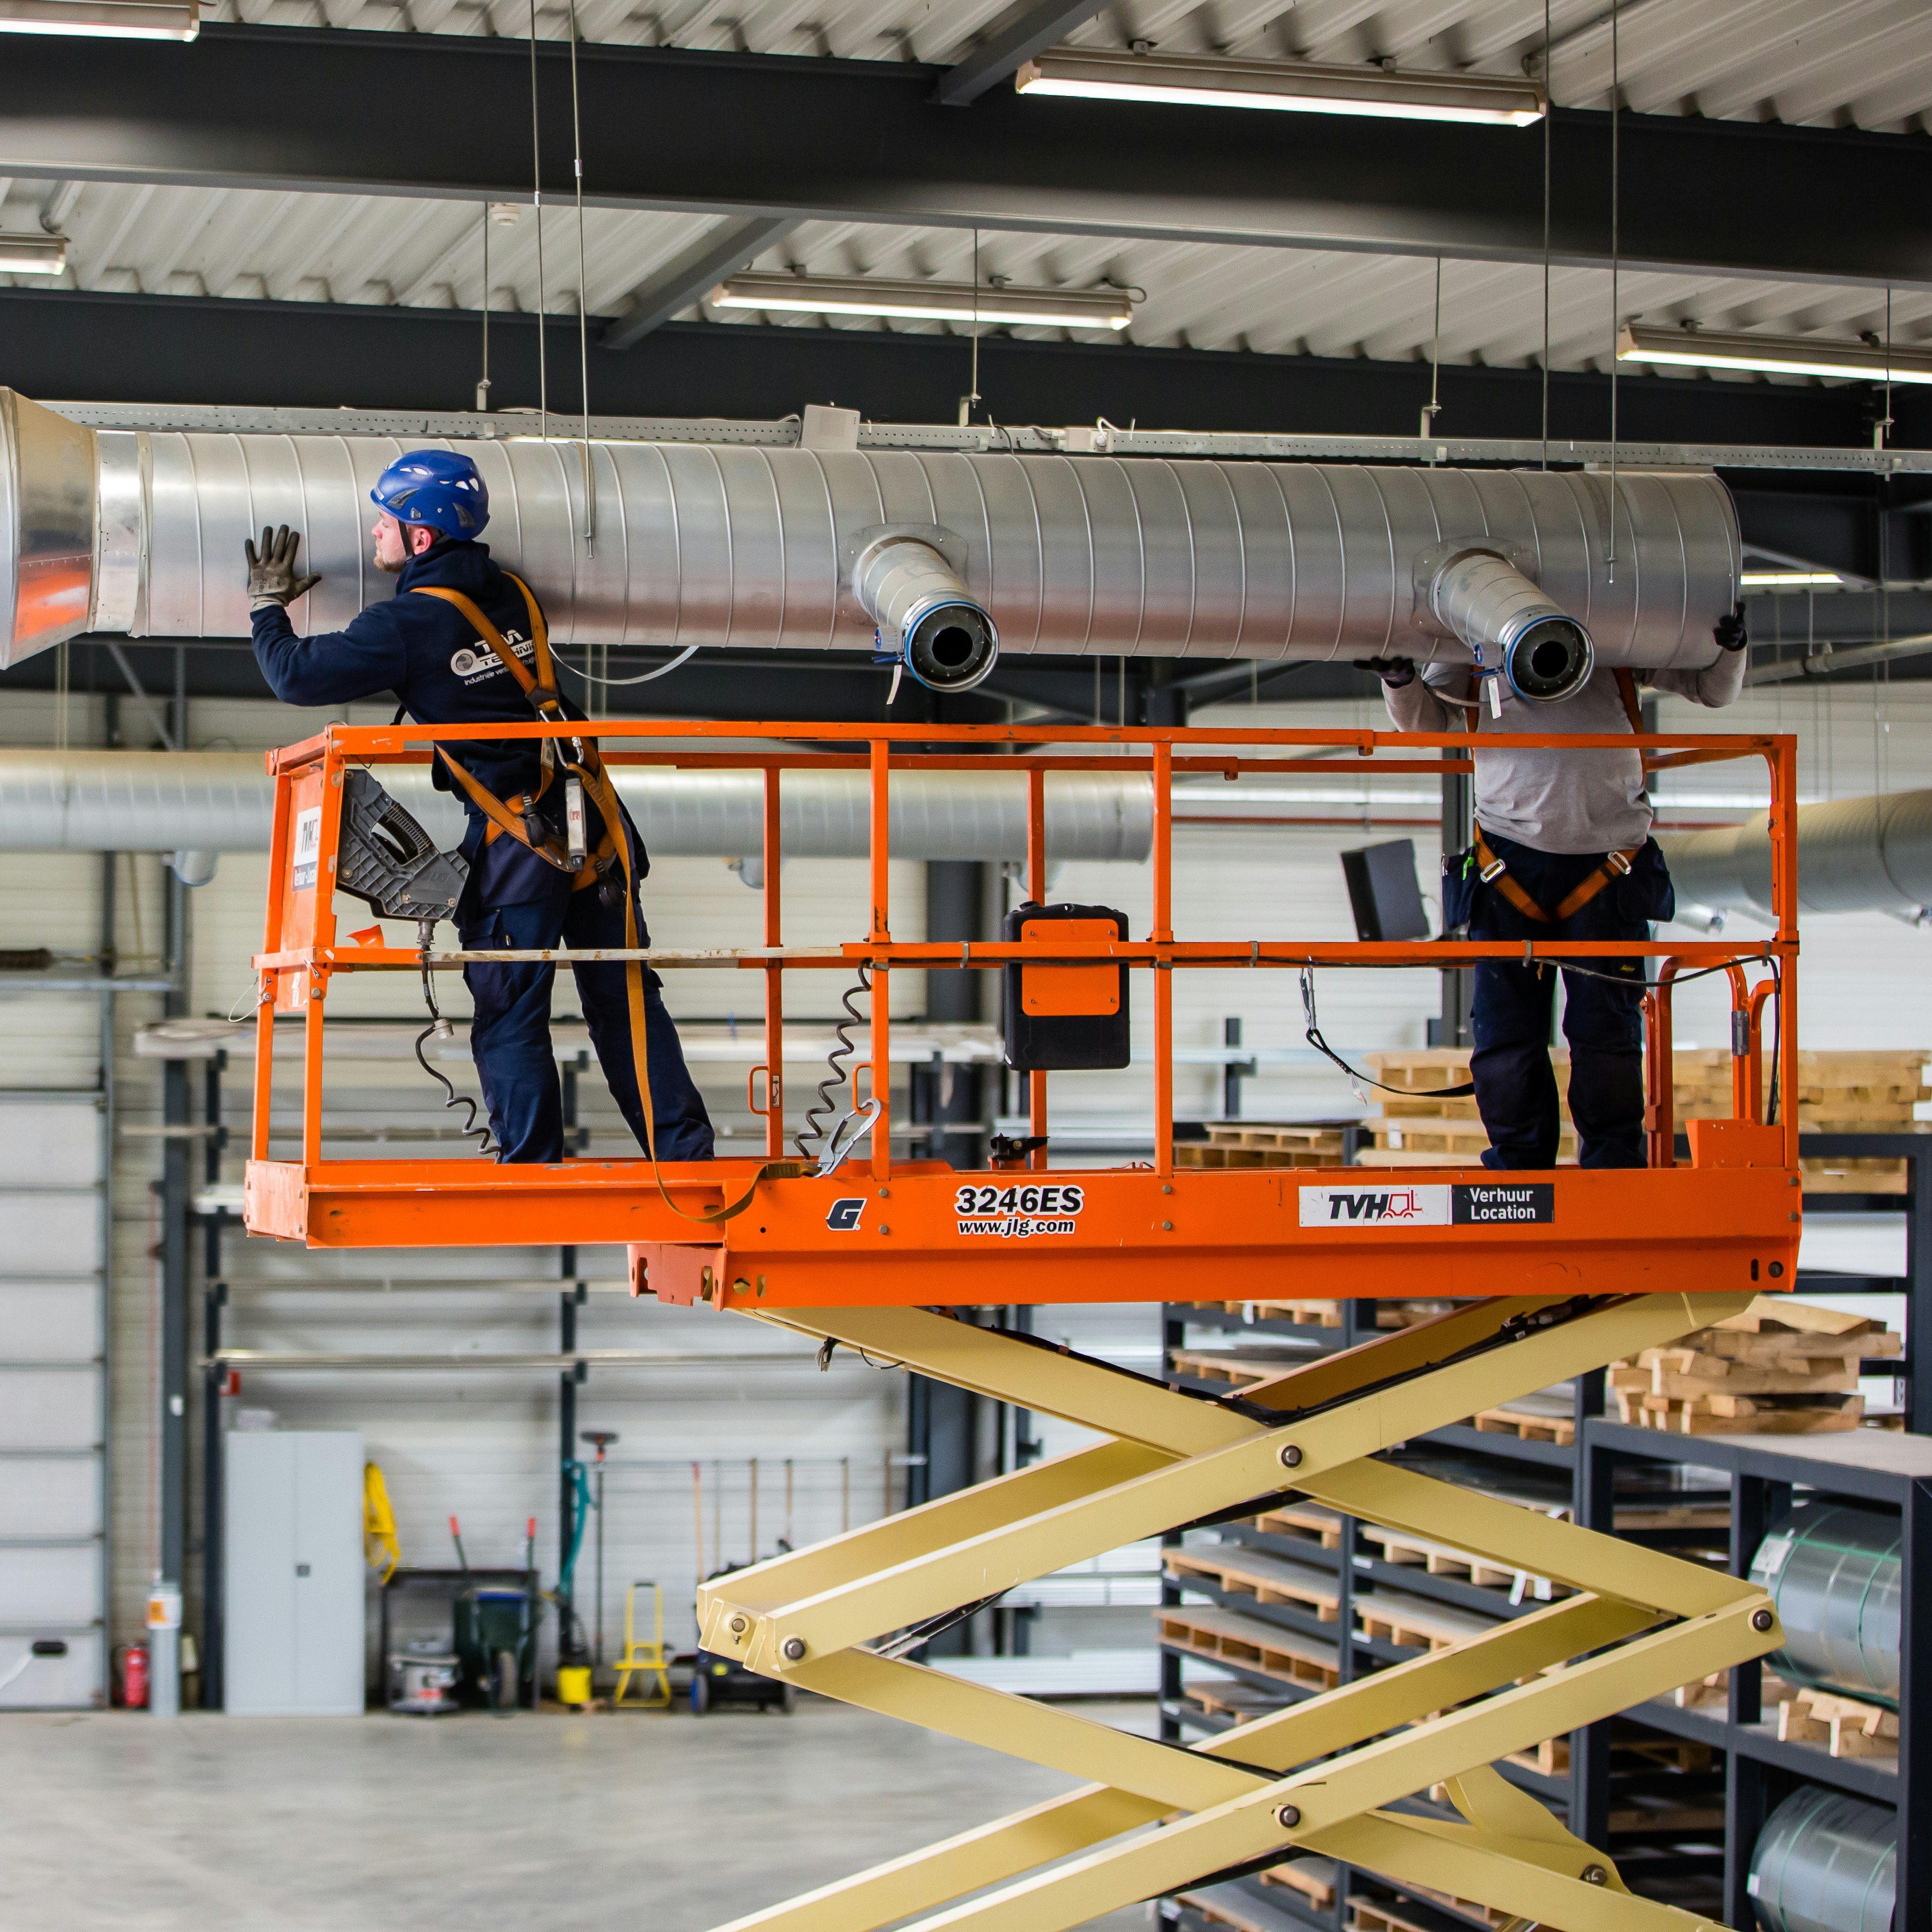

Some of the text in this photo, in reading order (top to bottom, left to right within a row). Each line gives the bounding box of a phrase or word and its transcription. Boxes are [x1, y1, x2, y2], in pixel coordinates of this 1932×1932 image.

[957, 1187, 1081, 1213] 3246ES
[1470, 1187, 1534, 1202] Verhuur
[1329, 1194, 1389, 1220] TVH
[1471, 1205, 1536, 1220] Location
[959, 1219, 1074, 1236] www.jlg.com
